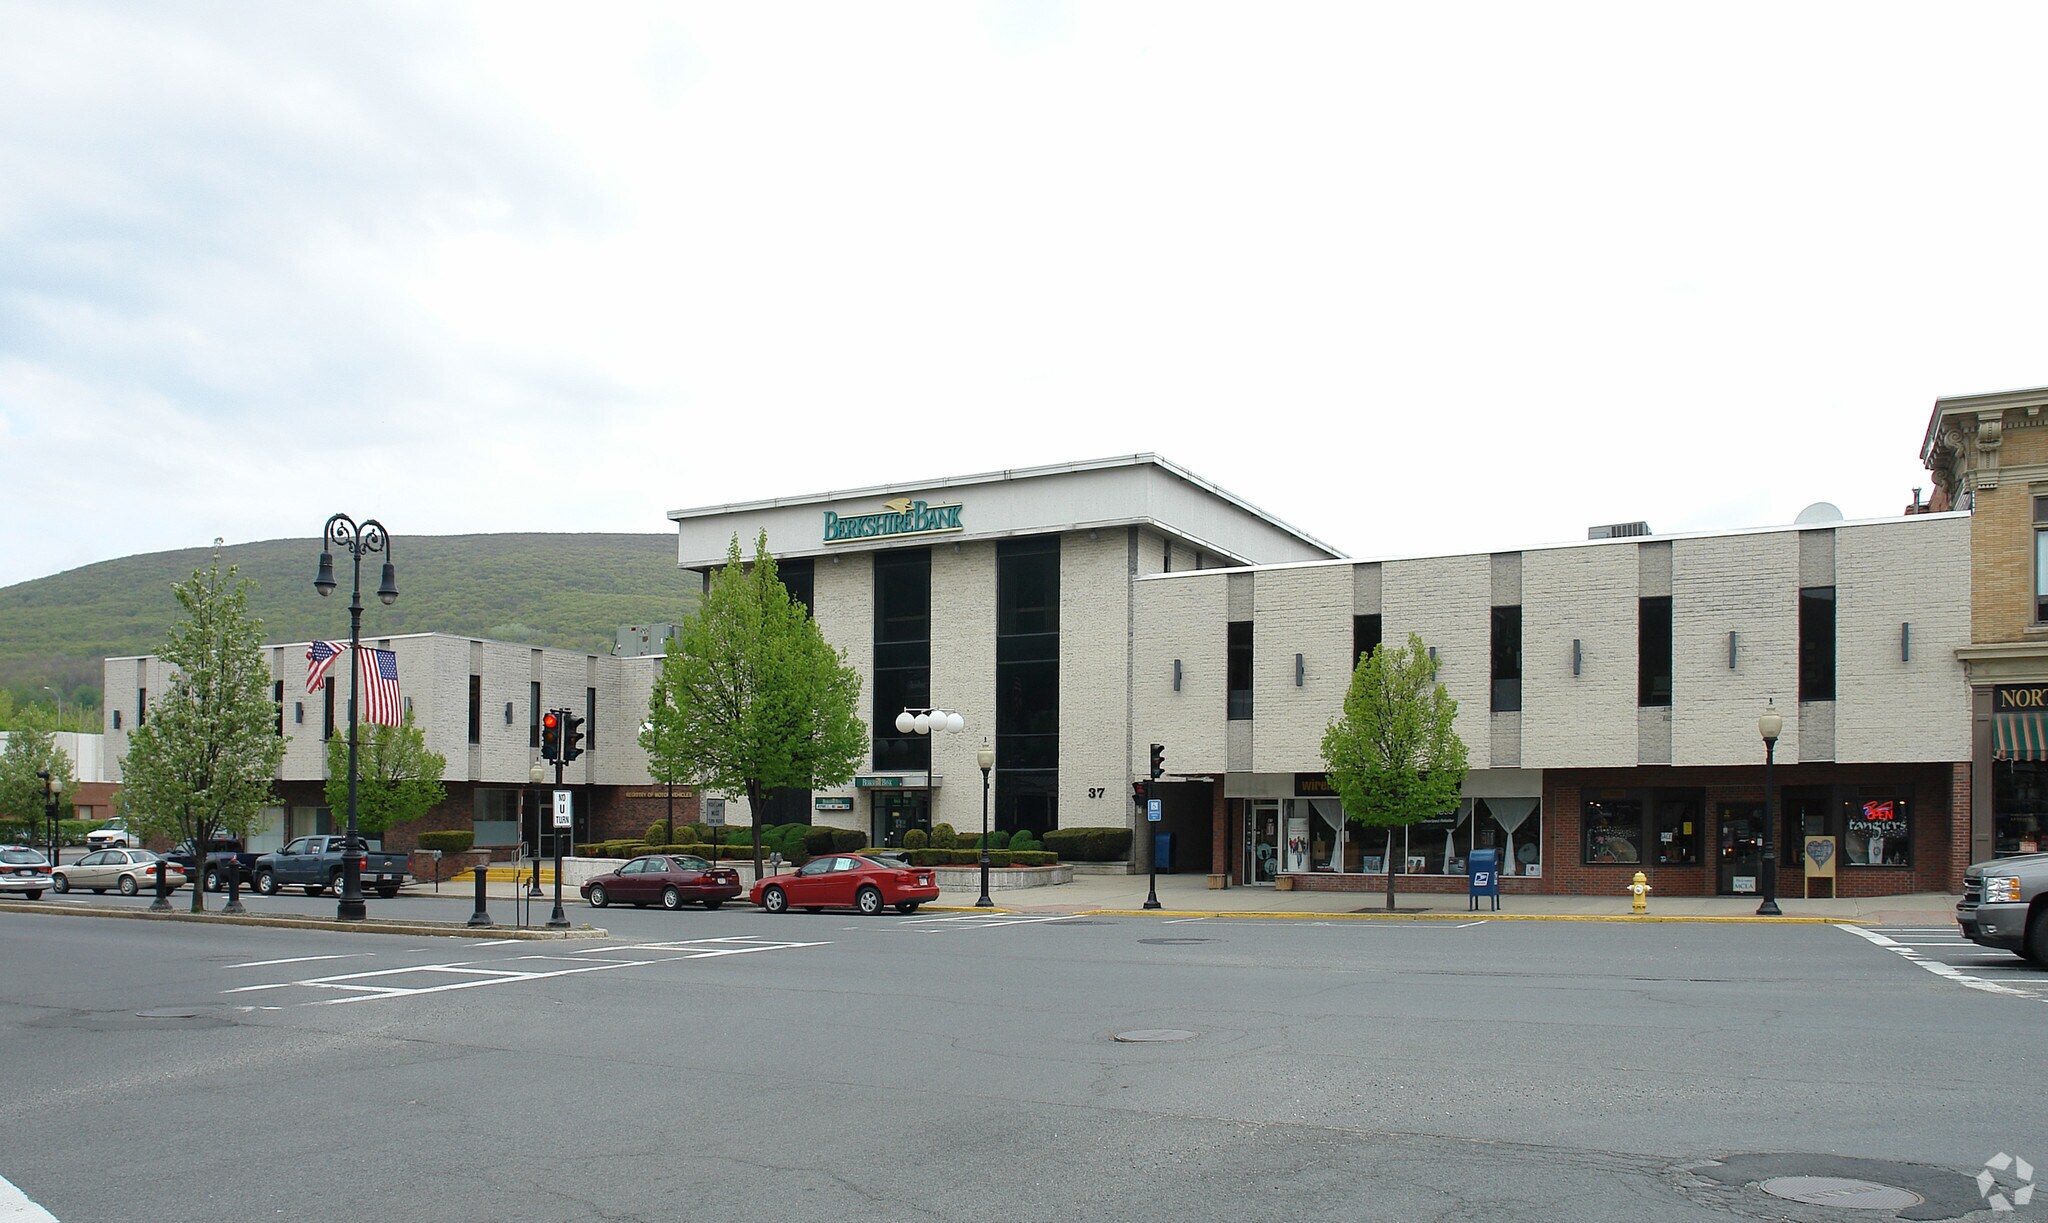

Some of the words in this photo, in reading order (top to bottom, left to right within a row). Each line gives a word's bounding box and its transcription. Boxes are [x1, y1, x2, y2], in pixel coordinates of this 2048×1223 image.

[1302, 779, 1330, 791] wire
[558, 793, 567, 802] NO
[1088, 787, 1106, 799] 37
[559, 804, 566, 814] U
[556, 815, 570, 824] TURN
[1866, 810, 1894, 820] OPEN
[1849, 819, 1907, 840] tangiers
